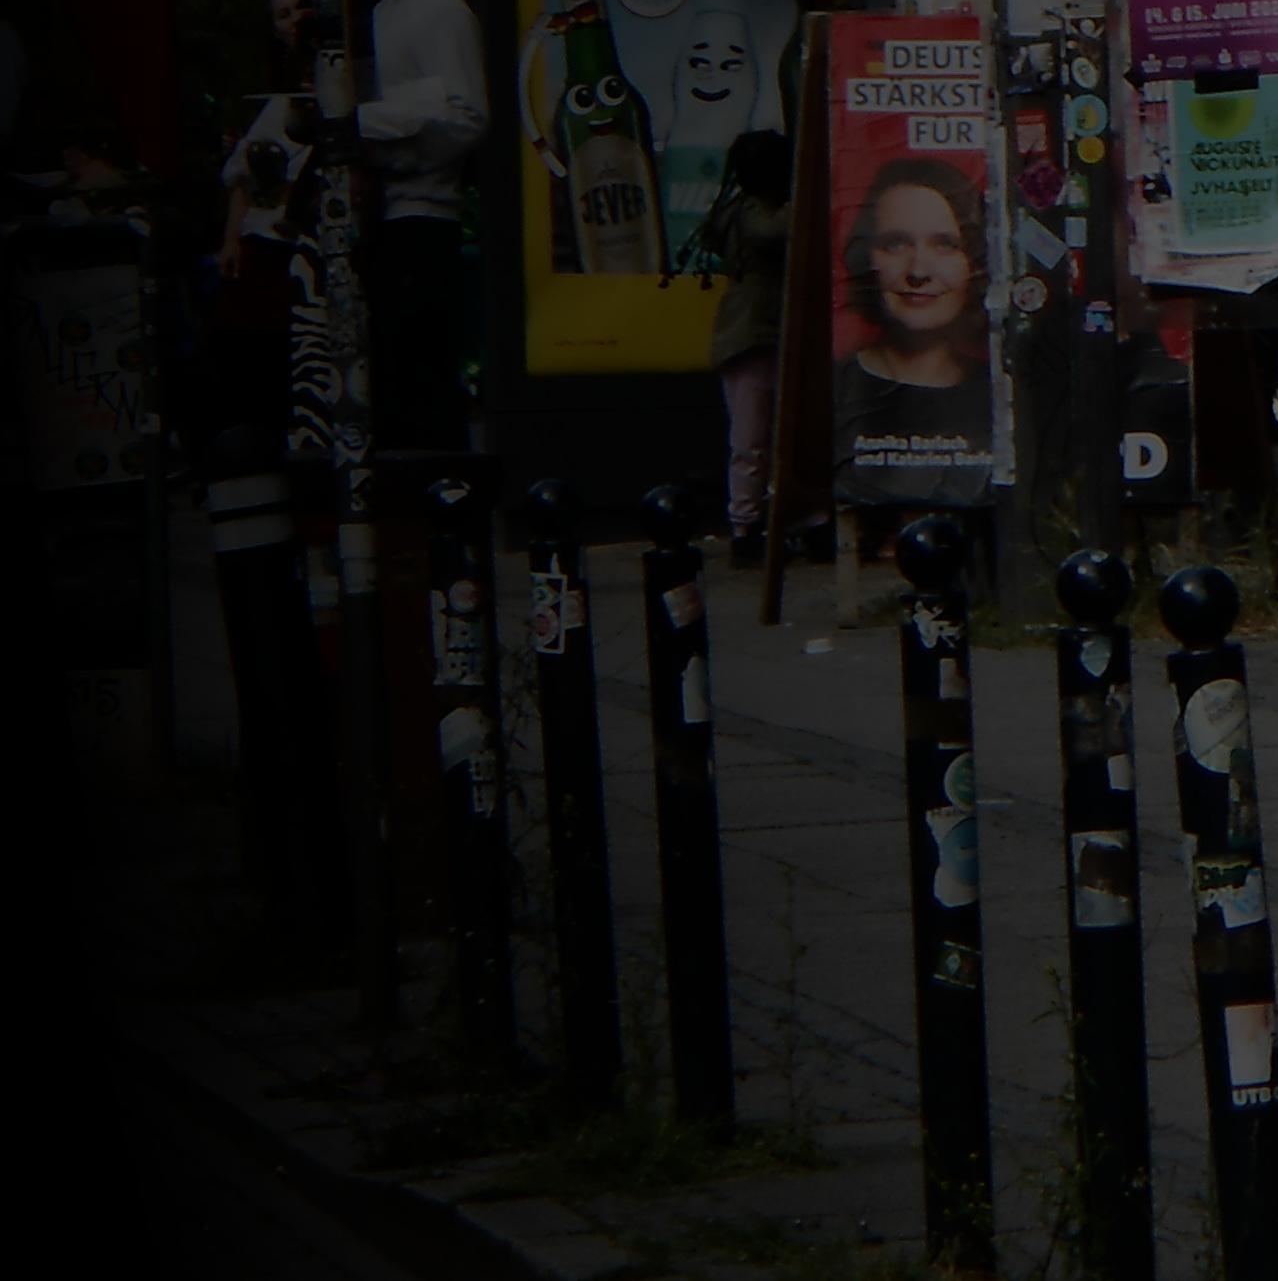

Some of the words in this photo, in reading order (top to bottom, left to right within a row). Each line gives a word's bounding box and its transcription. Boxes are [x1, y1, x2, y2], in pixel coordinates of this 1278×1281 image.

[854, 77, 984, 107] STÄRKST
[914, 115, 974, 145] FÜR
[580, 182, 648, 225] JEVER
